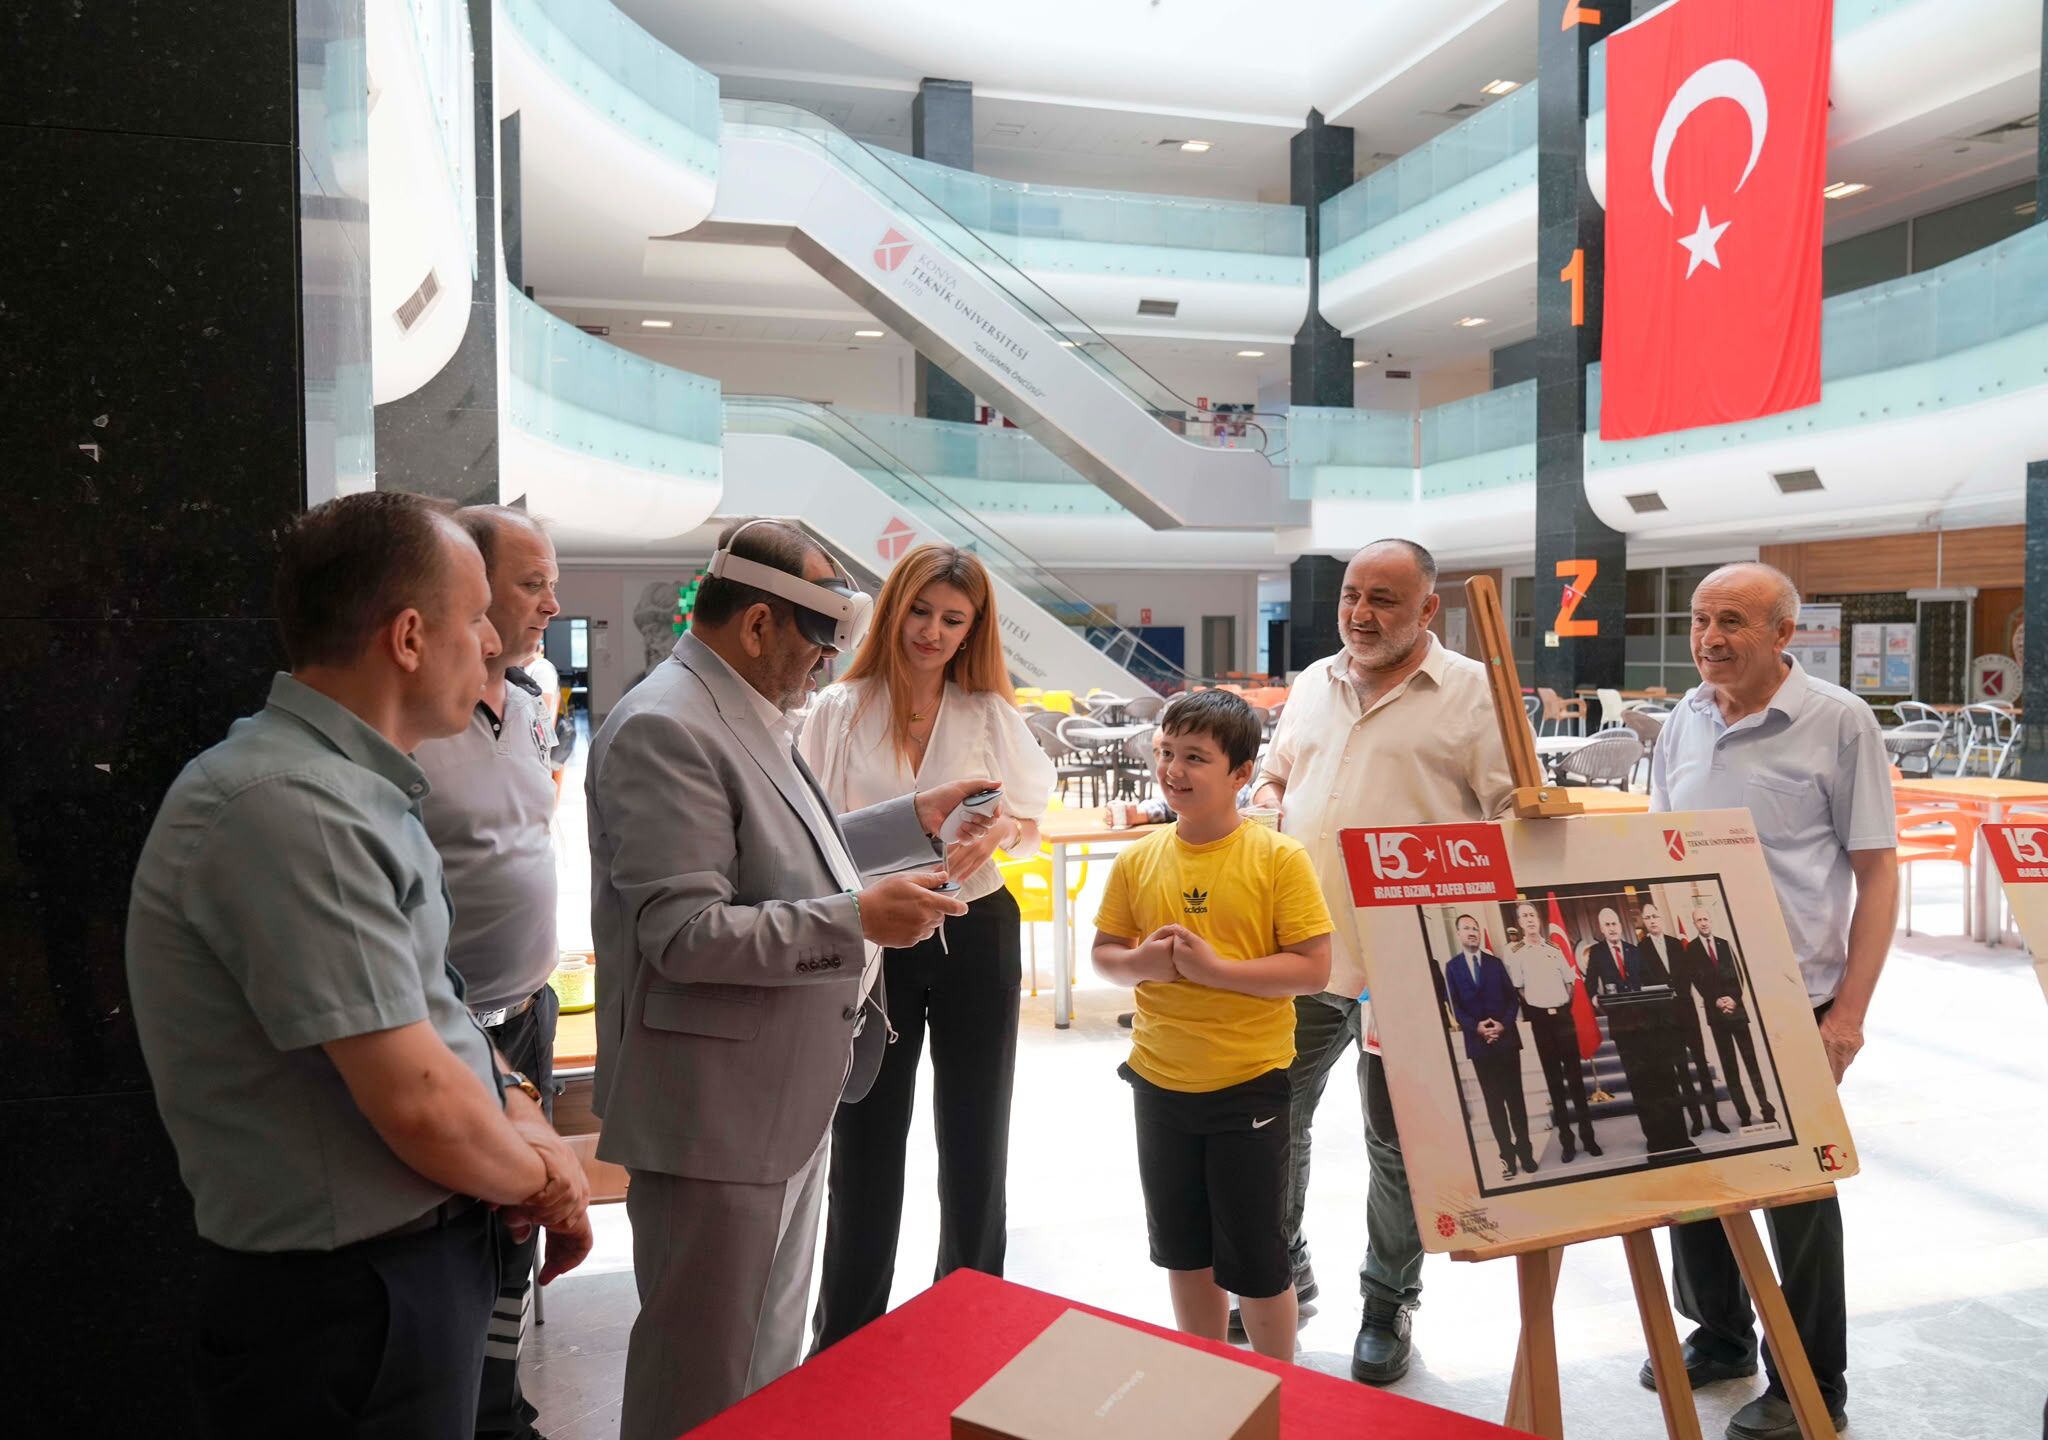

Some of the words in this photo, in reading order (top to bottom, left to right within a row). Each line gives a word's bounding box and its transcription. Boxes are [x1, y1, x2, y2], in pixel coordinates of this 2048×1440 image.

[919, 254, 957, 288] KONYA
[1561, 248, 1585, 327] 1
[1436, 882, 1466, 896] ZAFER
